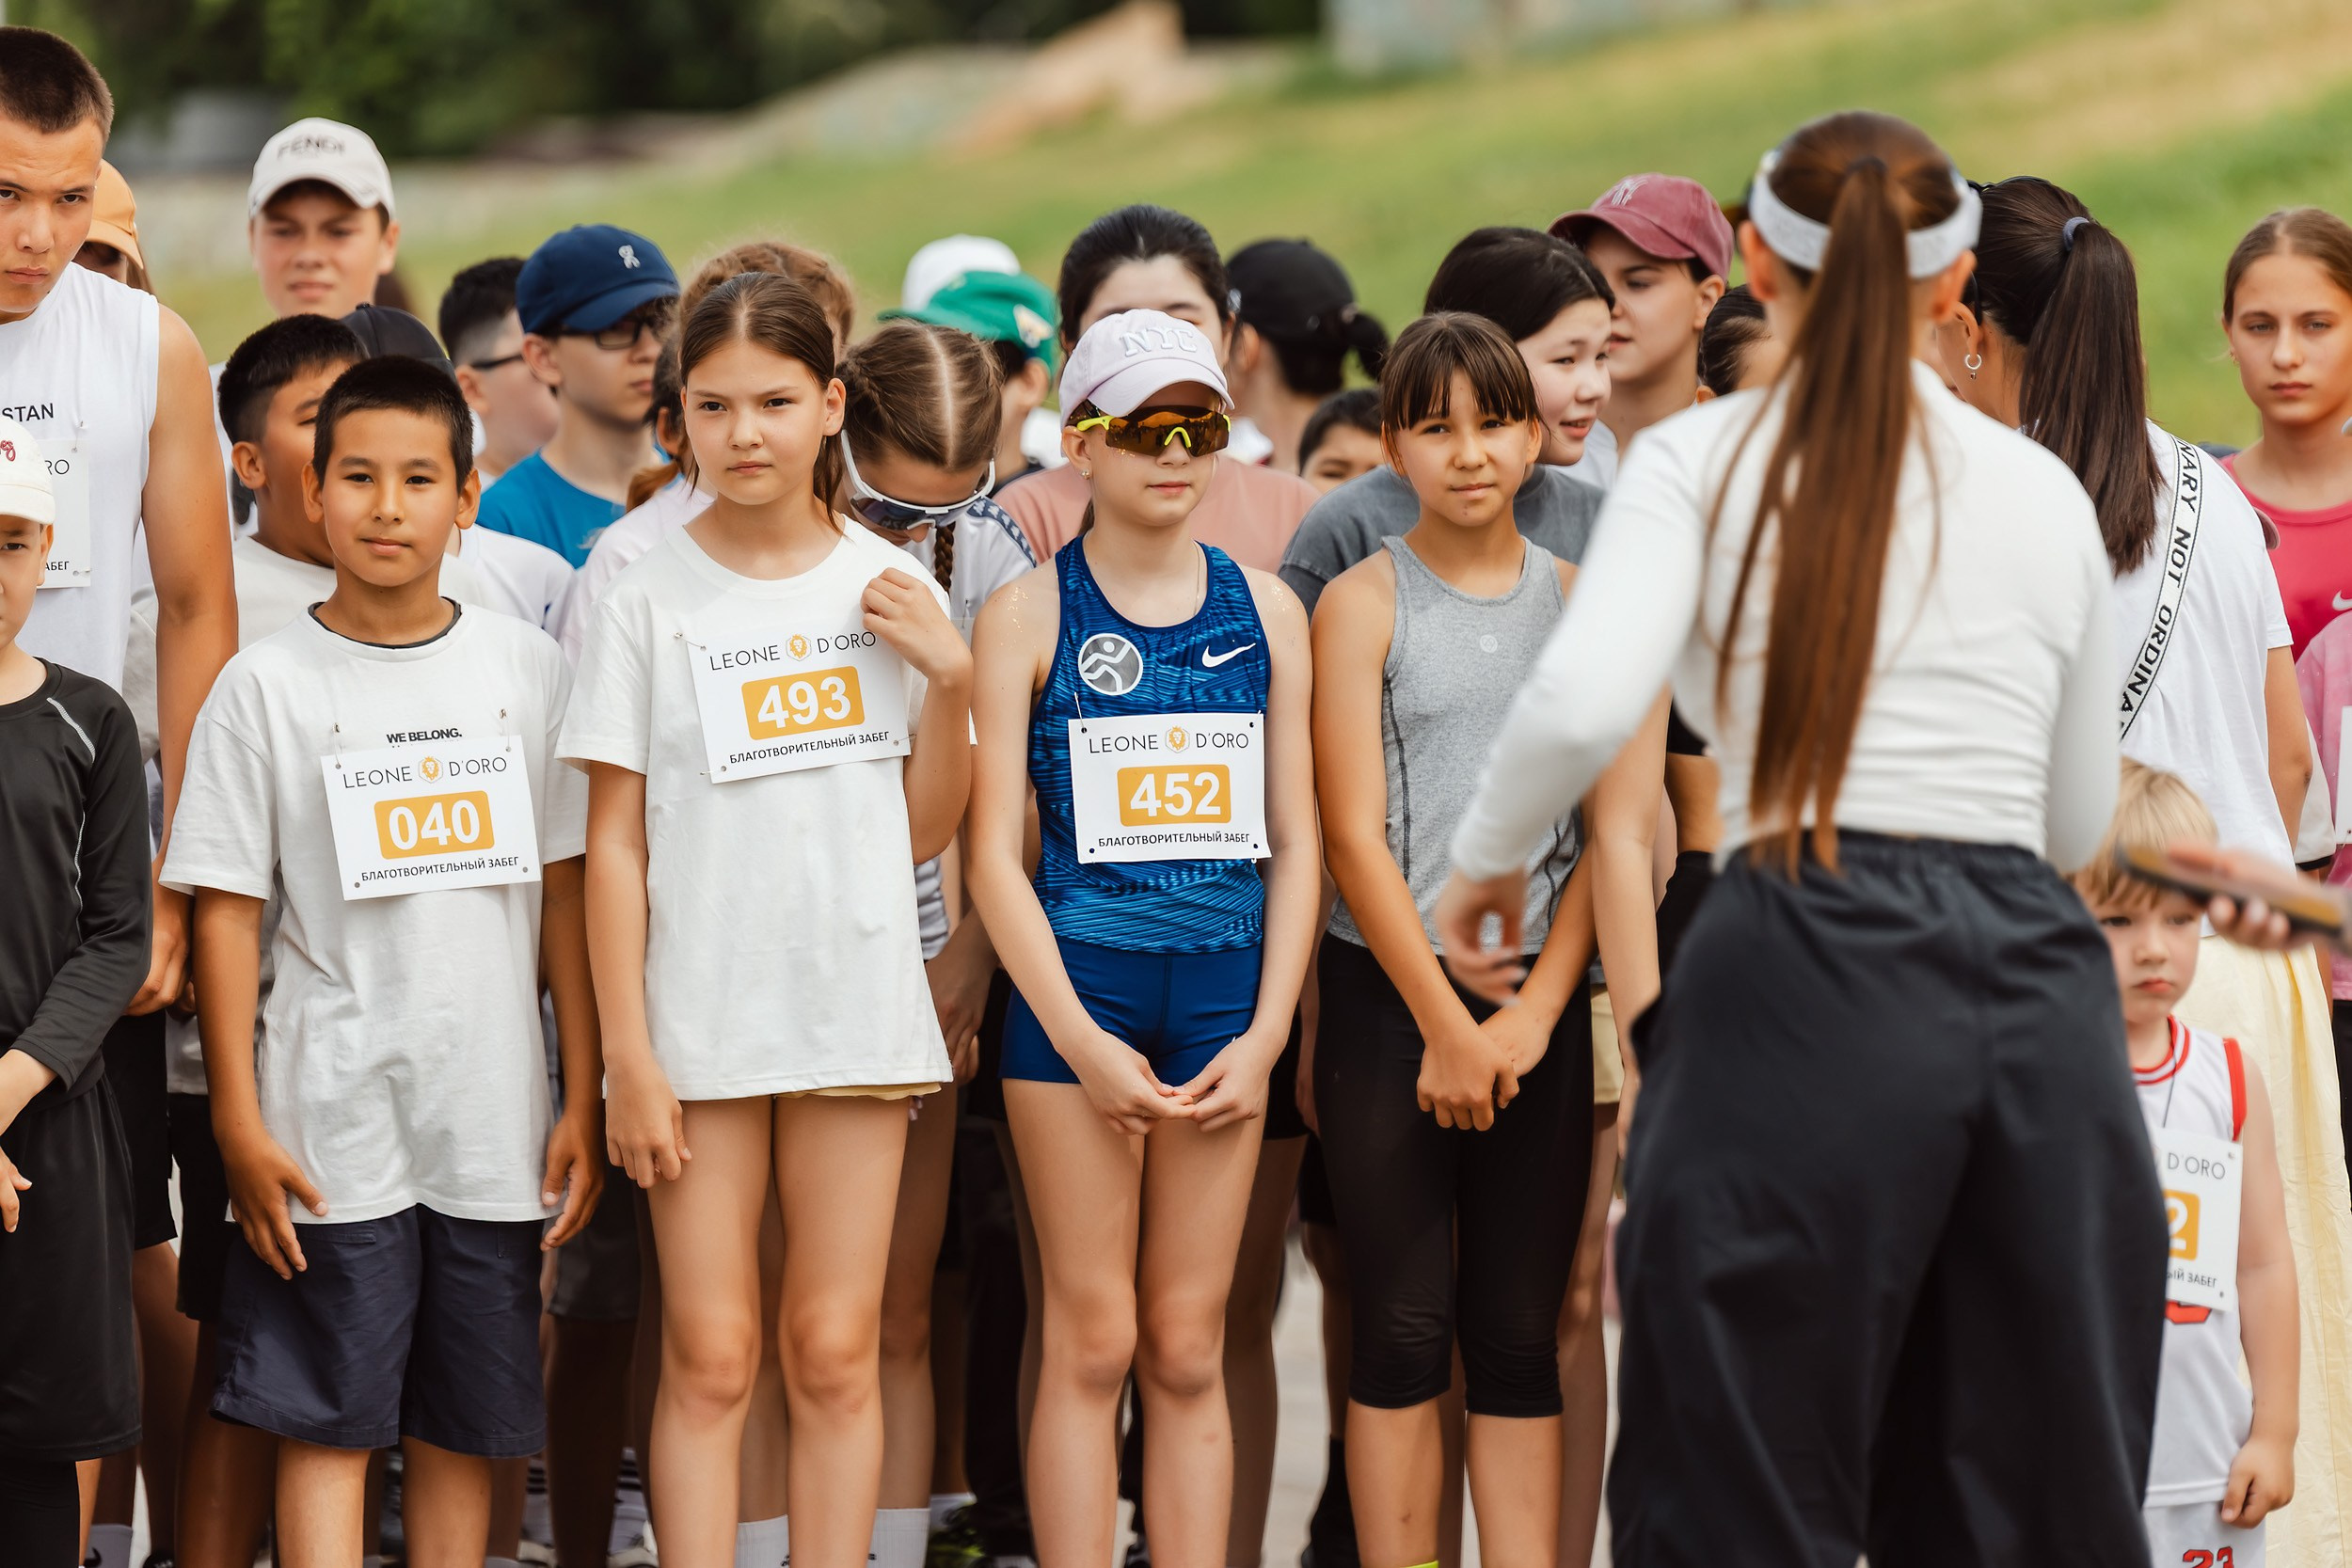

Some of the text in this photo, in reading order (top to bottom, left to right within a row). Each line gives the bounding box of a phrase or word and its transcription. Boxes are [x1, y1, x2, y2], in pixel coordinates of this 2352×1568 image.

[278, 135, 345, 160] FENDI
[1119, 327, 1197, 357] NYC
[2168, 526, 2191, 588] NOT
[710, 631, 877, 671] LEONE D'ORO
[2121, 605, 2172, 728] ORDINA
[757, 675, 851, 729] 493
[387, 733, 406, 744] WE
[408, 728, 463, 742] BELONG.
[729, 731, 890, 764] БЛАГОТВОРИТЕЛЬНЫЙ ЗАБЕГ
[1089, 733, 1249, 754] LEONE D'ORO
[342, 756, 507, 789] LEONE D'ORO
[1130, 771, 1221, 817] 452
[389, 800, 481, 850] 040
[1099, 832, 1250, 847] БЛАГОТВОРИТЕЛЬНЫЙ ЗАБЕГ
[361, 856, 519, 881] БЛАГОТВОРИТЕЛЬНЫЙ ЗАБЕГ
[2186, 1272, 2217, 1289] ЗАБЕГ
